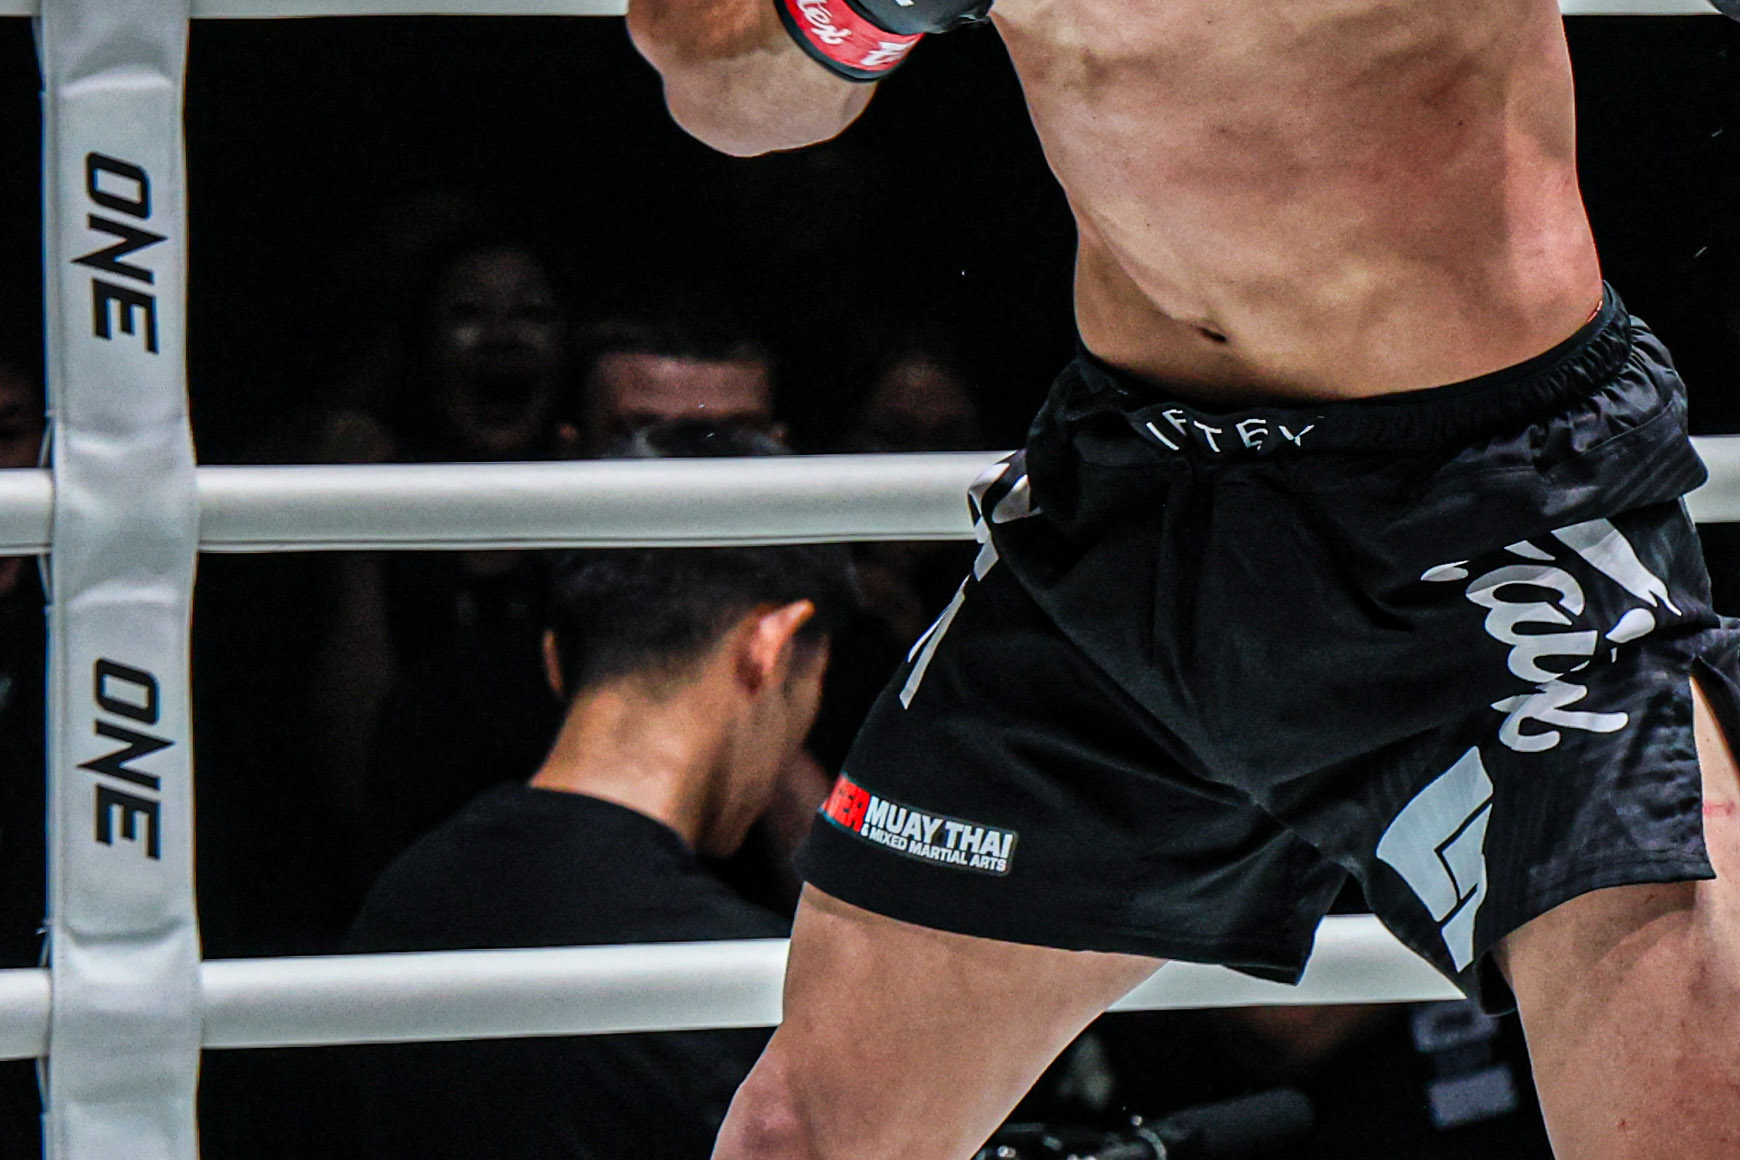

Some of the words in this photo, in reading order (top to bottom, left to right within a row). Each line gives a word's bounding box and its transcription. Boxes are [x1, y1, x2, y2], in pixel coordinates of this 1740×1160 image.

[70, 151, 169, 355] ONE
[76, 657, 176, 861] ONE
[864, 795, 943, 845] MUAY
[944, 820, 1014, 859] THAI
[868, 826, 909, 852] MIXED
[908, 840, 968, 865] MARTIAL
[969, 855, 1007, 873] ARTS
